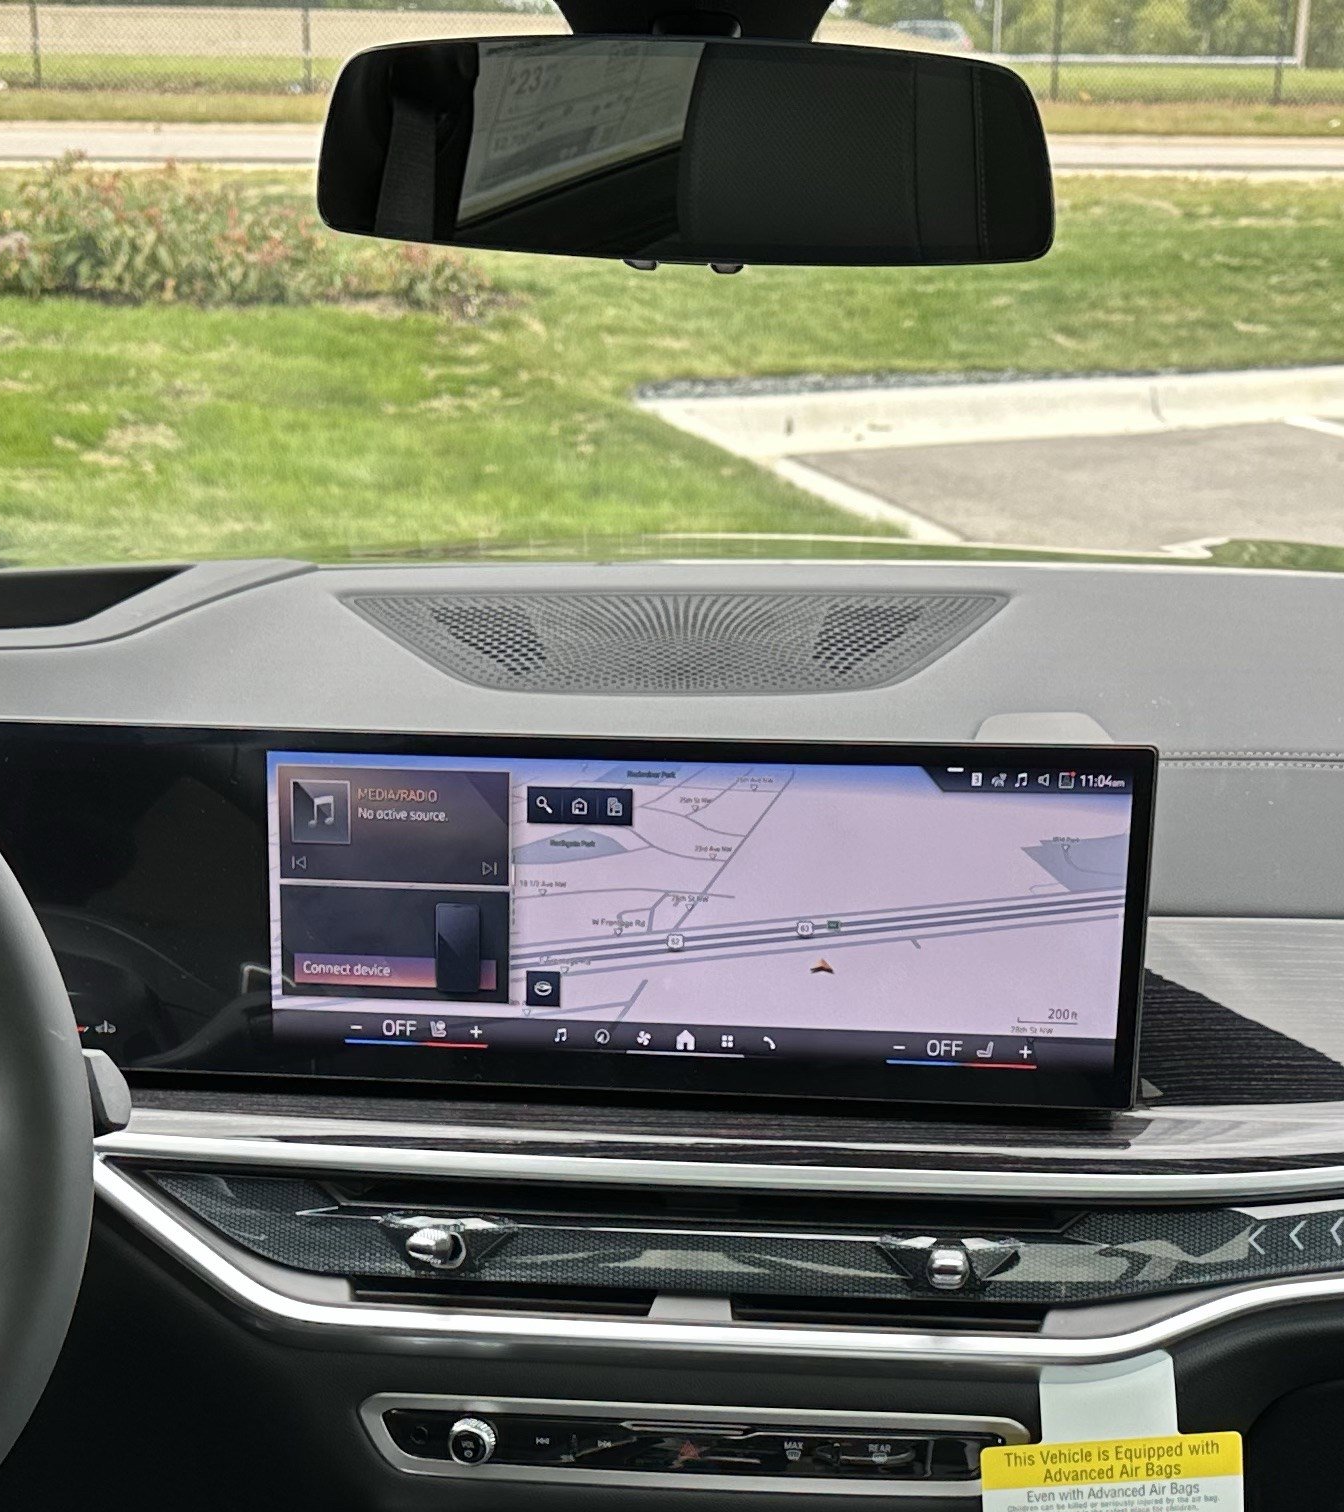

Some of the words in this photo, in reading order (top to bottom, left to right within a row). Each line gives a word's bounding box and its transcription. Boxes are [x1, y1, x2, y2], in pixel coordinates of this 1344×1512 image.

[357, 788, 438, 804] MEDIA/RADIO
[358, 807, 376, 820] No
[377, 809, 408, 822] active
[409, 810, 449, 822] source.
[303, 961, 351, 976] Connect
[354, 963, 391, 977] device
[382, 1020, 417, 1037] OFF
[926, 1040, 963, 1057] OFF
[784, 1441, 804, 1450] MAX
[1004, 1451, 1035, 1467] This
[1039, 1447, 1092, 1465] Vehicle
[1096, 1446, 1109, 1461] is
[1114, 1442, 1183, 1463] Equipped
[1188, 1439, 1219, 1456] with
[1042, 1464, 1114, 1483] Advanced
[1118, 1462, 1141, 1478] Air
[1145, 1460, 1181, 1479] Bags
[1026, 1489, 1055, 1503] Even
[1058, 1488, 1083, 1501] with
[1086, 1484, 1145, 1499] Advanced
[1148, 1482, 1167, 1495] Air
[1169, 1480, 1200, 1497] Bags
